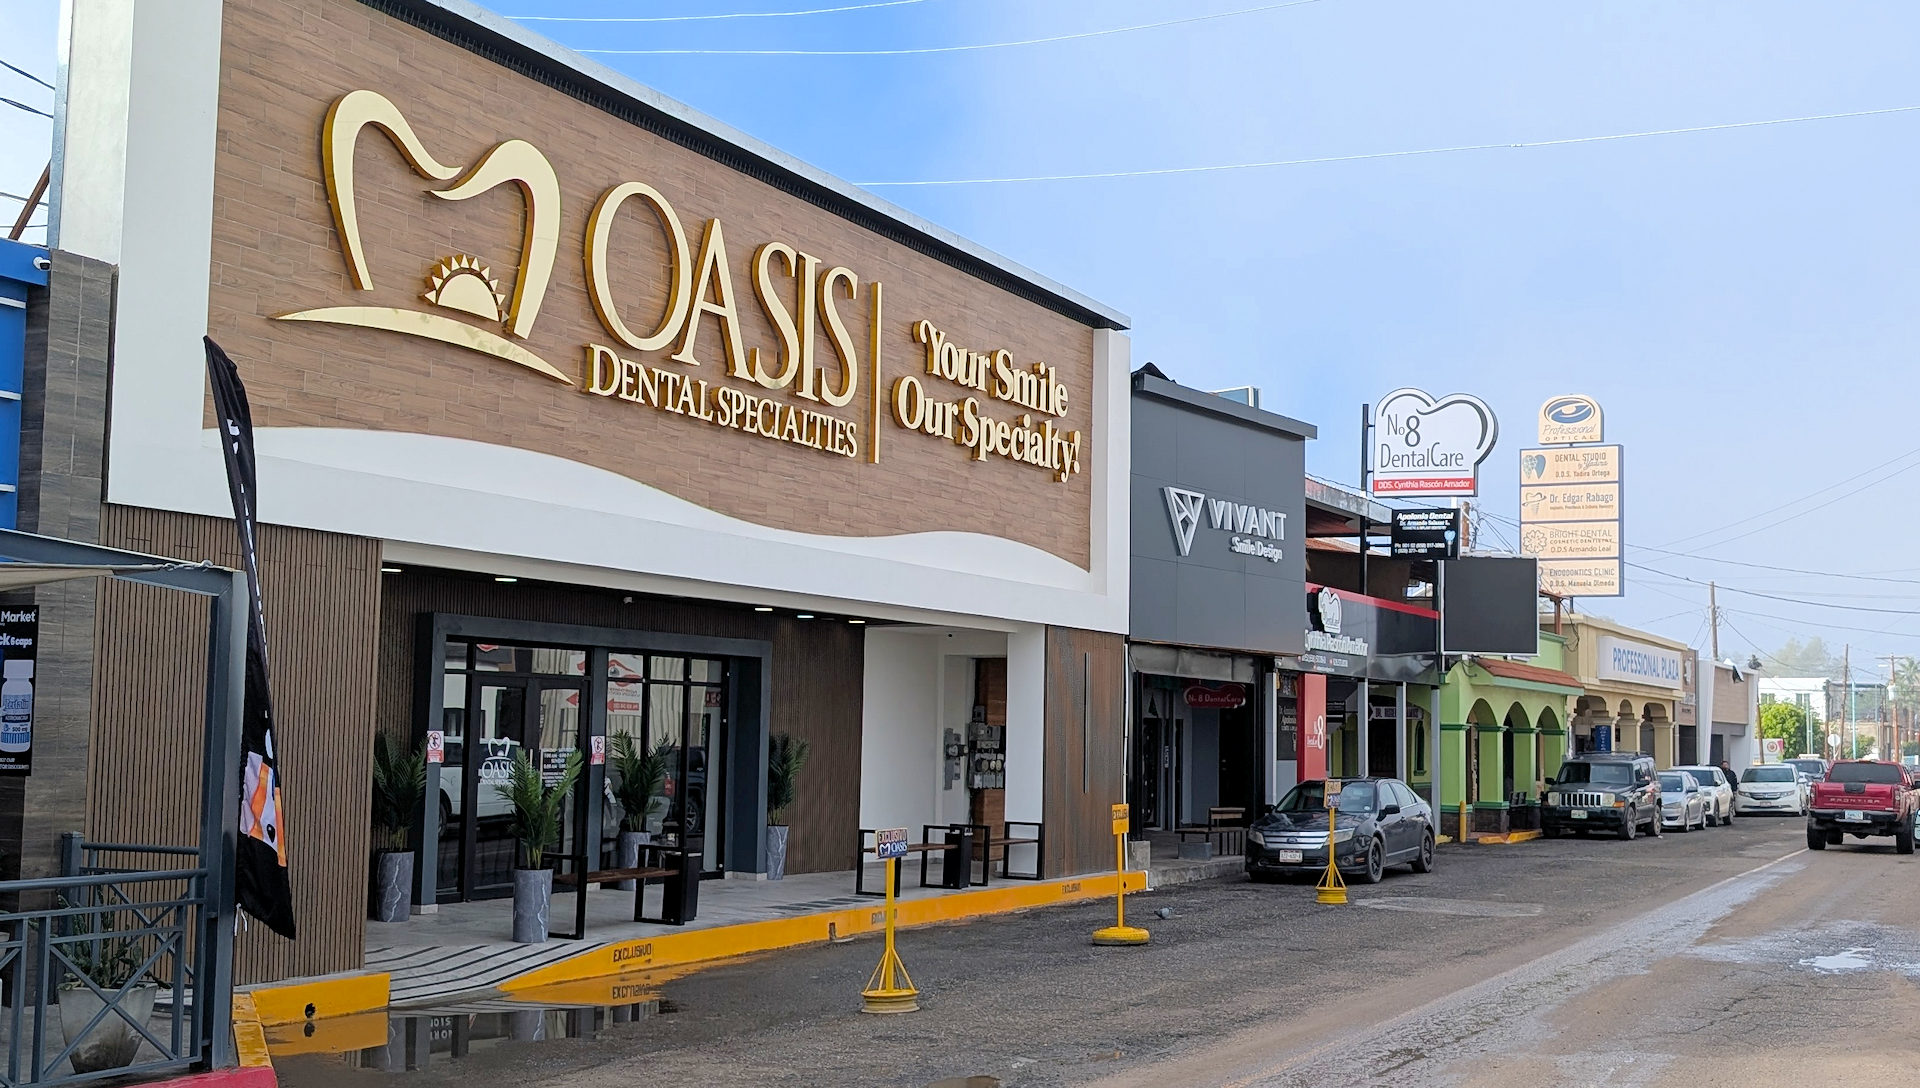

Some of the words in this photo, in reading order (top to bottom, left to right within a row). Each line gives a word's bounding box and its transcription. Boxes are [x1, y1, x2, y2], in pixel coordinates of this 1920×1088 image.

[585, 181, 858, 407] OASIS
[912, 319, 991, 392] Your
[989, 349, 1069, 418] Smile
[582, 343, 714, 422] DENTAL
[712, 386, 858, 459] SPECIALTIES
[892, 375, 958, 440] Our
[956, 397, 1081, 483] Specialty!
[1543, 424, 1596, 435] Professional
[1555, 453, 1580, 463] DENTAL
[1582, 452, 1606, 461] STUDIO
[1591, 469, 1610, 478] Ortega
[1394, 481, 1418, 490] Cynthia
[1420, 480, 1442, 488] Rascón
[1549, 494, 1560, 503] Dr.
[1562, 492, 1583, 504] Edgar
[1586, 492, 1614, 503] Rabago
[1207, 498, 1287, 540] VIVANT
[1396, 512, 1428, 522] Apolonia
[1429, 512, 1454, 520] Dental
[1549, 530, 1578, 538] BRIGHT
[1580, 529, 1612, 538] DENTAL
[1230, 536, 1255, 555] Smile
[1254, 541, 1283, 563] Design
[1549, 568, 1592, 577] ENDODONTICS
[1593, 567, 1615, 576] CLINIC
[1, 610, 36, 622] Market
[1613, 647, 1660, 677] PROFESSIONAL
[1660, 657, 1680, 680] PLAZA
[482, 761, 516, 779] OASIS
[1829, 797, 1880, 805] FRONTIER
[878, 830, 908, 844] EXCLUSIVO
[891, 841, 907, 853] OASIS
[613, 943, 652, 962] EXCLUSIVO
